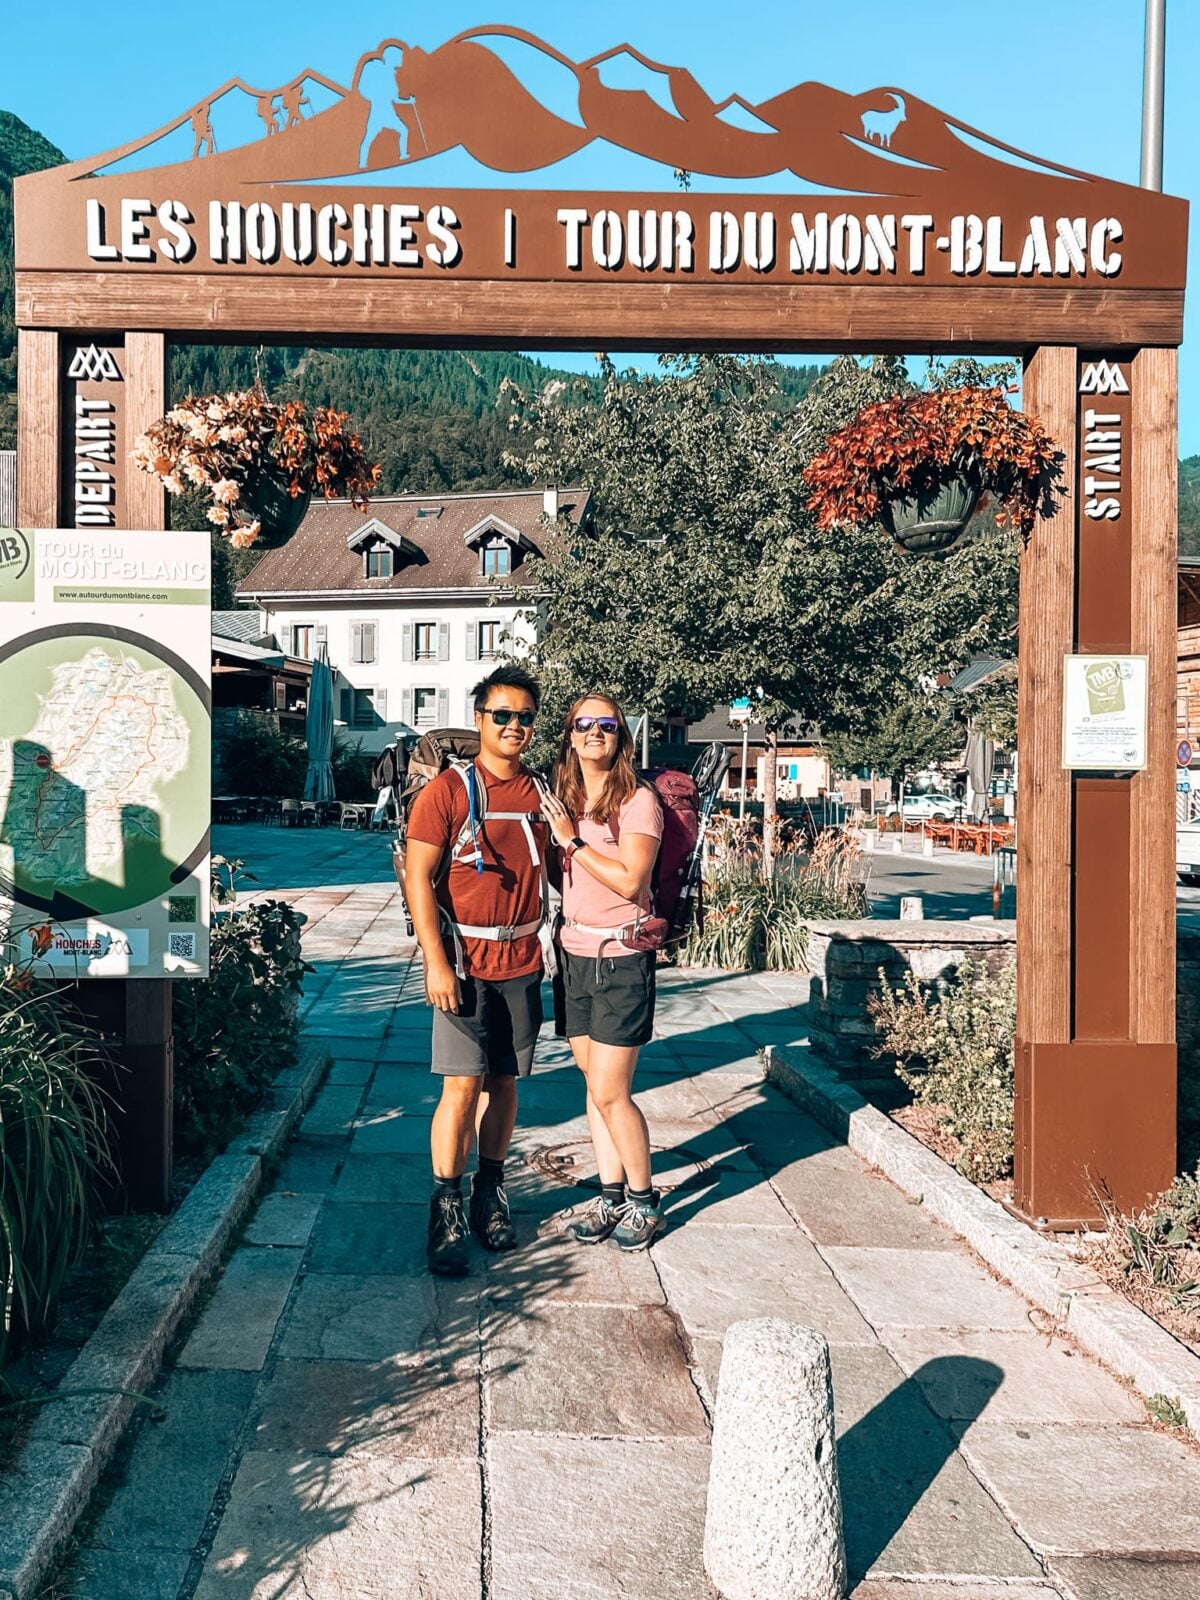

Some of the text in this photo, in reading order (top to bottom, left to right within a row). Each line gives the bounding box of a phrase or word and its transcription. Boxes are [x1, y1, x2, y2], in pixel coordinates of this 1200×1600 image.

[86, 198, 194, 262] LES
[208, 200, 460, 267] HOUCHES
[556, 208, 693, 270] TOUR
[708, 210, 775, 272] DU
[789, 211, 1124, 277] MONT-BLANC
[75, 395, 114, 526] DEPART
[1084, 409, 1121, 520] START
[40, 542, 94, 558] TOUR
[100, 543, 124, 559] du
[40, 559, 207, 582] MONT-BLANC
[58, 591, 168, 600] www.autourdumontblanc.com
[56, 939, 101, 949] HOUCHES
